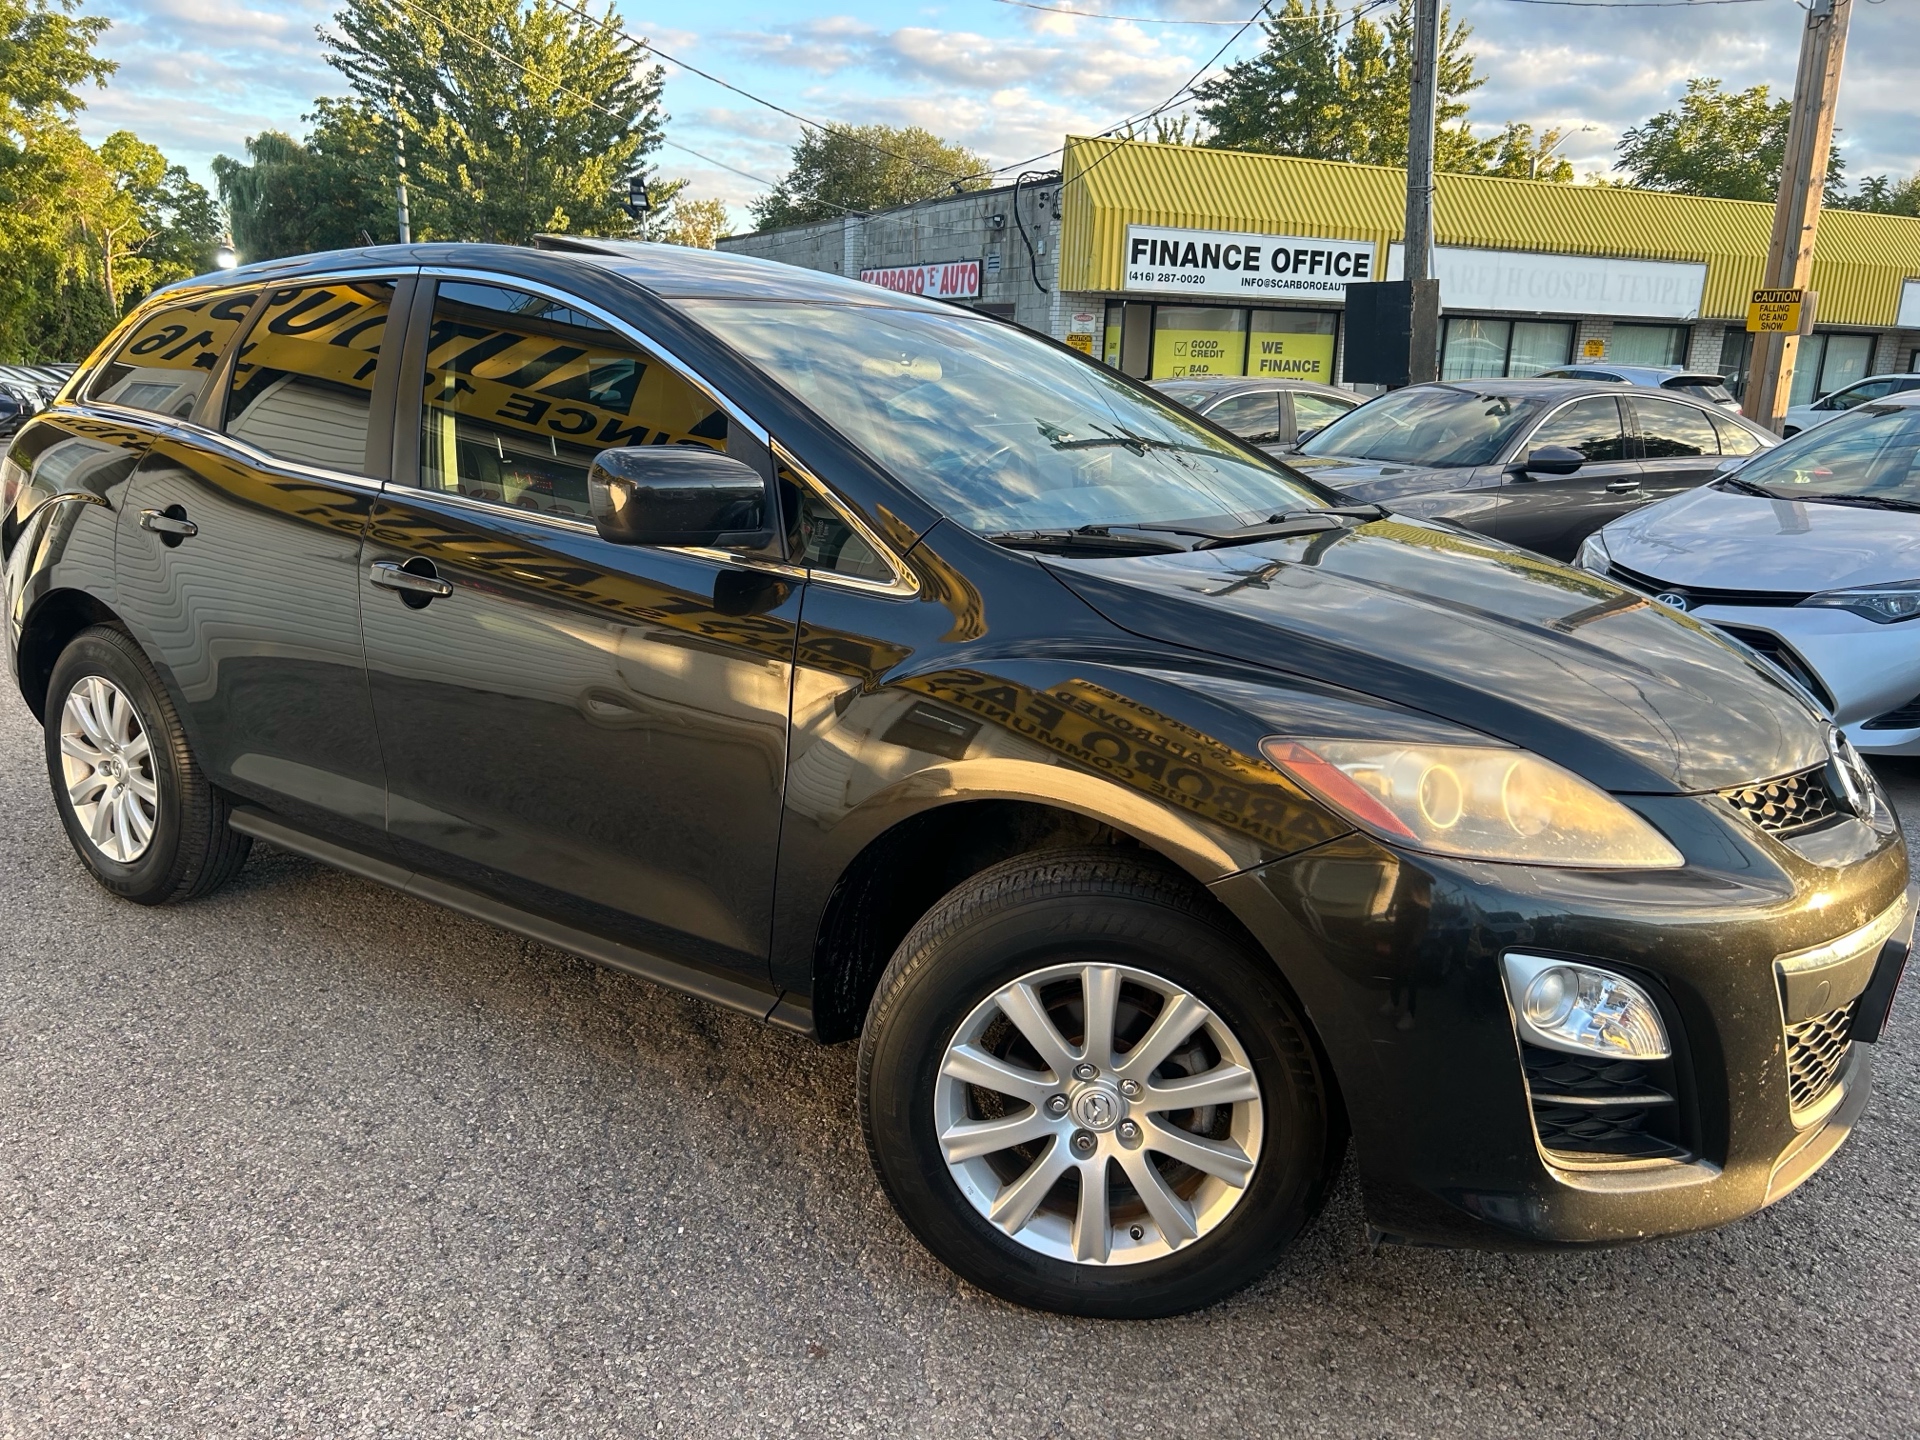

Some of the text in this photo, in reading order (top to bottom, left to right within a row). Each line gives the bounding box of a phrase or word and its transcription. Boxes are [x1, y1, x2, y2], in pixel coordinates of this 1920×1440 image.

[1131, 238, 1370, 278] FINANCE OFFICE
[940, 263, 978, 295] AUTO
[1129, 270, 1206, 285] (416) 287-0020
[1527, 267, 1611, 302] GOSPEL
[1618, 273, 1698, 306] TEMPLE
[1754, 291, 1800, 302] CAUTION
[1759, 304, 1790, 312] FALLING
[1758, 313, 1788, 321] ICE AND
[1760, 322, 1783, 330] SNOW
[1191, 340, 1218, 349] GOOD
[1261, 341, 1283, 354] WE
[1190, 350, 1225, 358] CREDIT
[1189, 365, 1209, 373] BAD
[1259, 360, 1320, 373] FINANCE
